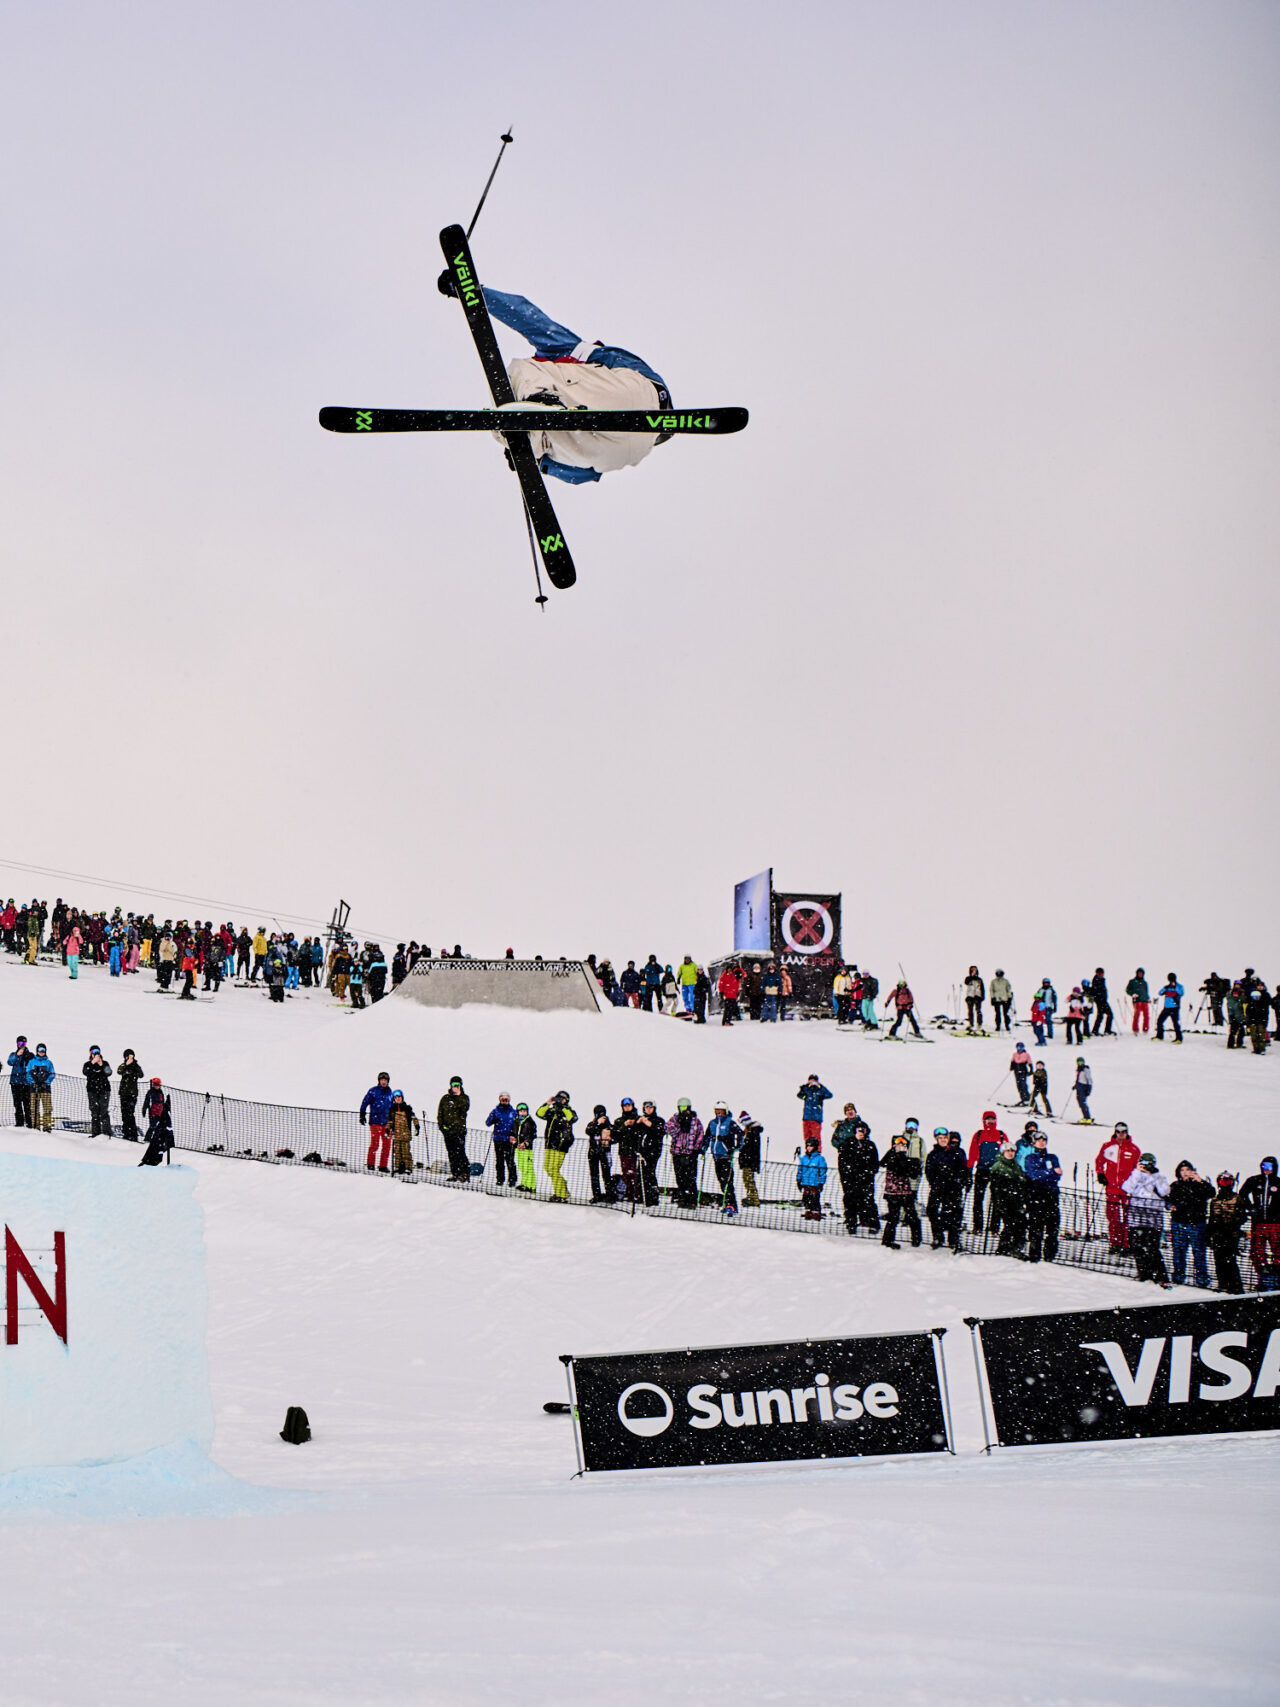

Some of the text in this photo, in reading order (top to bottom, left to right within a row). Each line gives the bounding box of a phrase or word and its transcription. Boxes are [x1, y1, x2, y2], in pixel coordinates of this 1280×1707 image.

[453, 251, 480, 307] Völkl
[645, 415, 711, 428] Völkl
[687, 1373, 899, 1429] Sunrise
